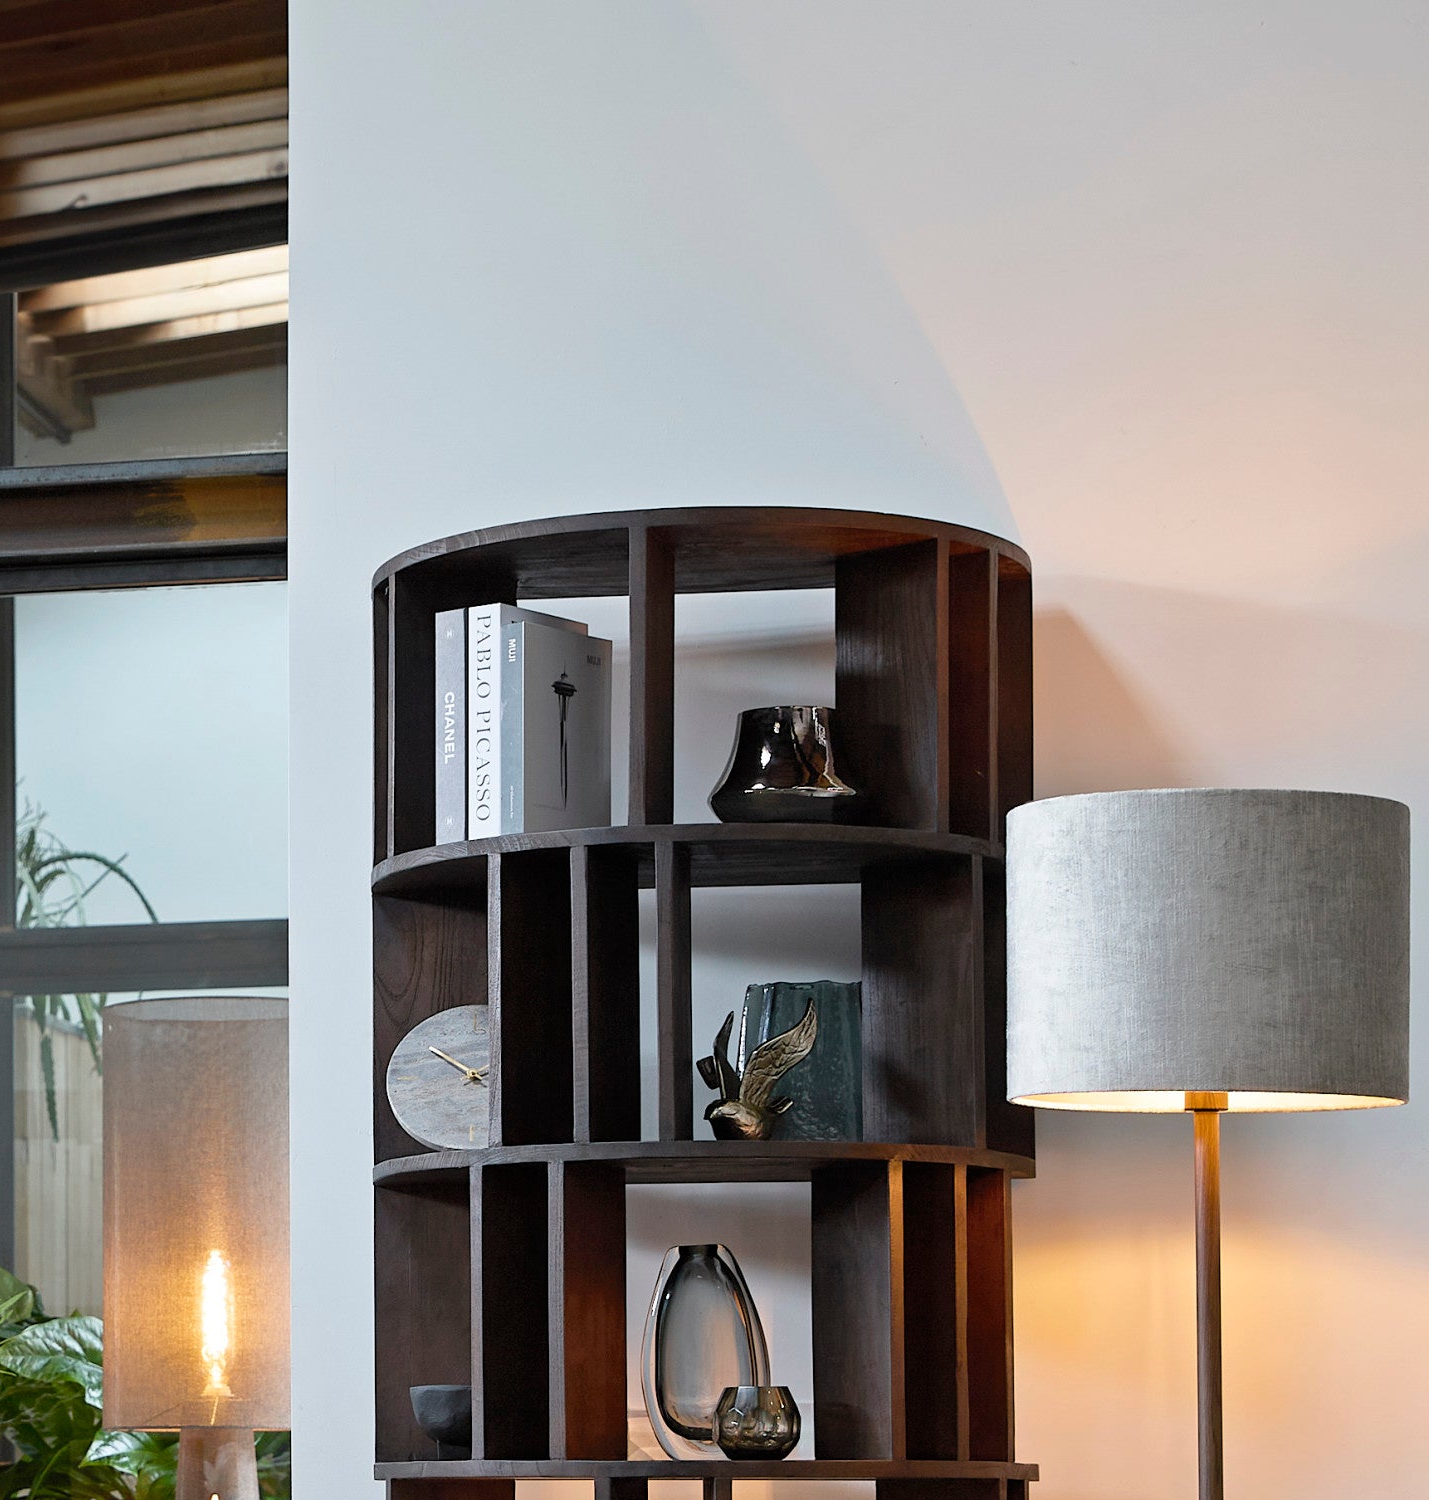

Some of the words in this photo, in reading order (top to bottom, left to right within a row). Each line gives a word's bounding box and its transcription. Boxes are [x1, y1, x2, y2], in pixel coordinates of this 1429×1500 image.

[476, 614, 491, 699] PABLO
[444, 691, 456, 764] CHANEL
[476, 710, 491, 822] PICASSO
